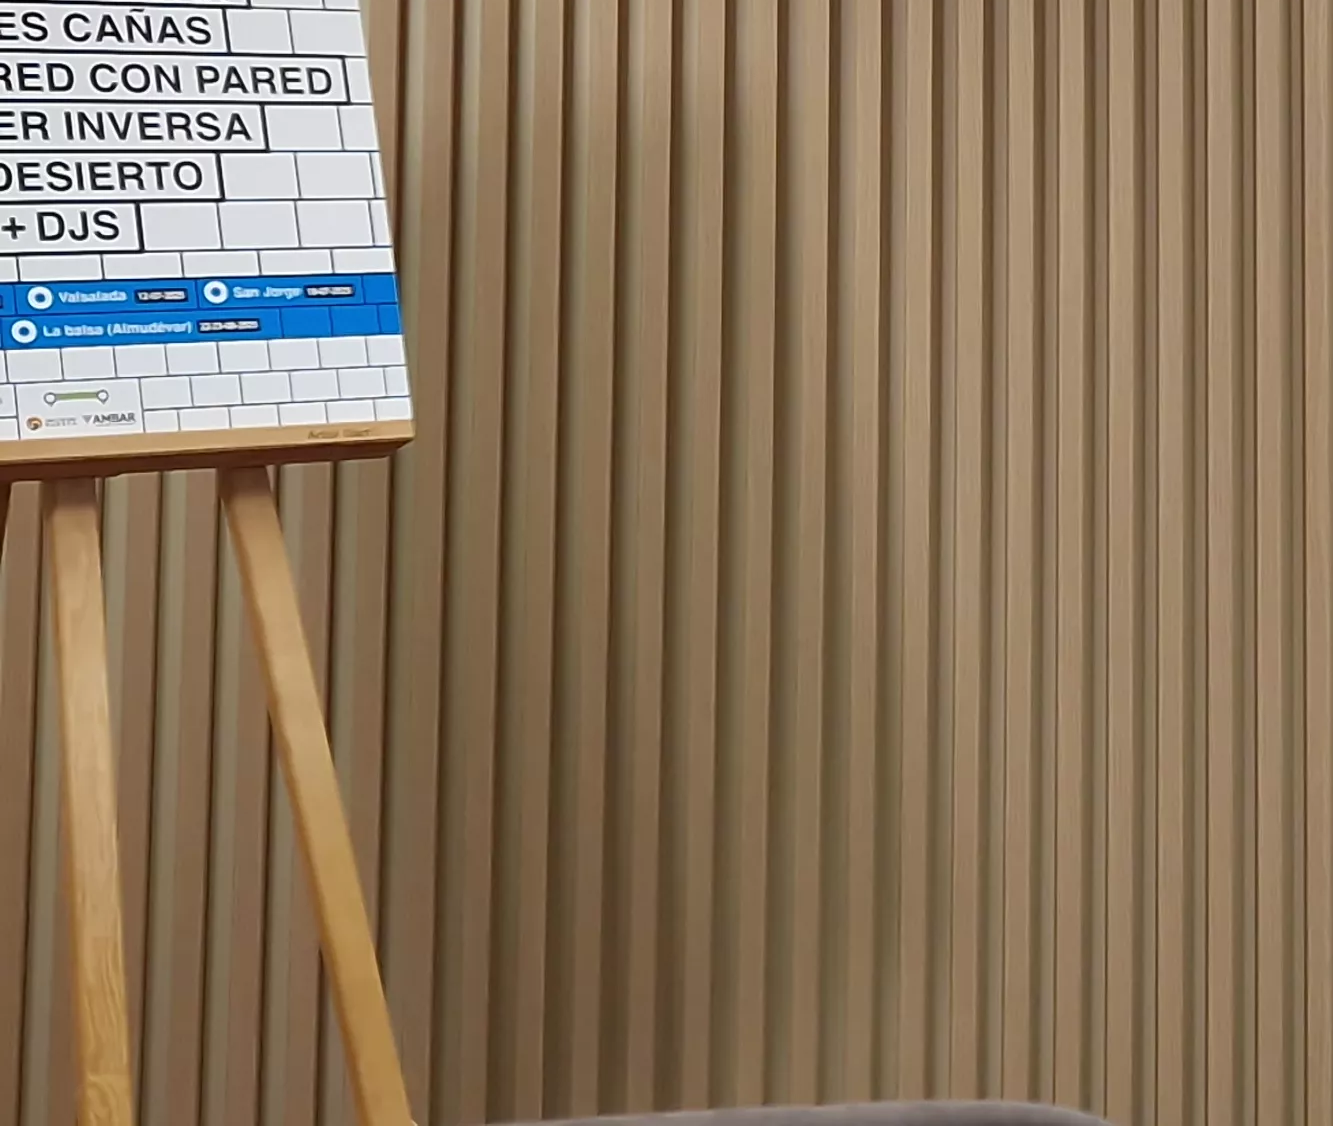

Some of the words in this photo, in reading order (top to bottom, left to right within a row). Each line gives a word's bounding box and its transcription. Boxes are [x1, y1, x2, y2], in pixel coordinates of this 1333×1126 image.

[63, 8, 212, 45] CAÑAS
[89, 63, 182, 93] CON
[195, 65, 333, 96] PARED
[64, 111, 253, 141] INVERSA
[36, 210, 120, 242] DJS
[233, 286, 259, 299] San
[263, 285, 302, 301] Jorge
[43, 325, 60, 337] La
[107, 320, 193, 337] (Almudévar)
